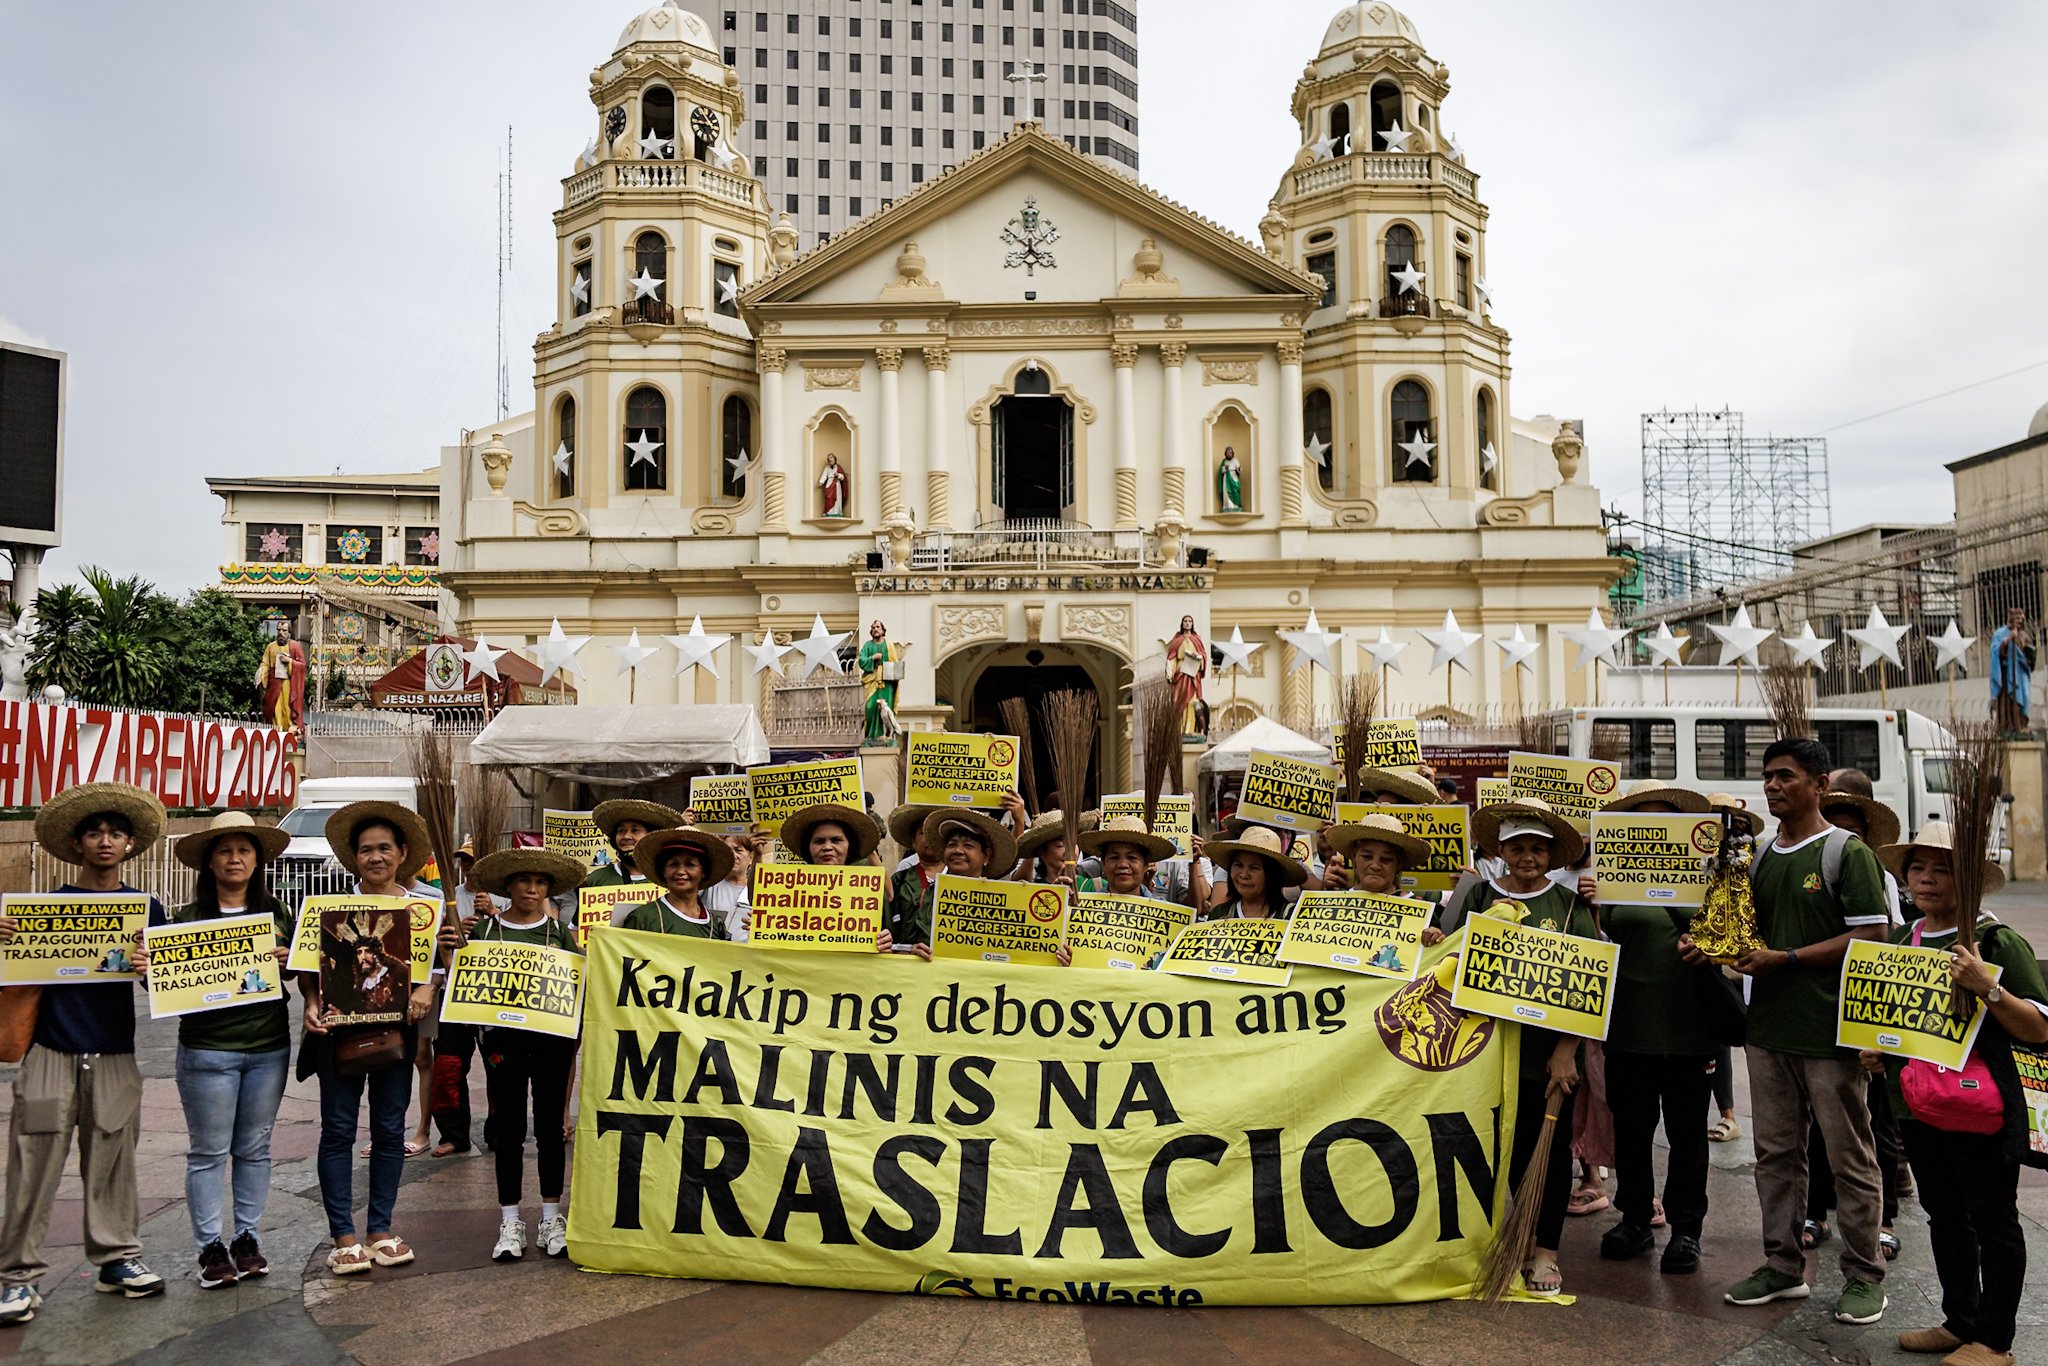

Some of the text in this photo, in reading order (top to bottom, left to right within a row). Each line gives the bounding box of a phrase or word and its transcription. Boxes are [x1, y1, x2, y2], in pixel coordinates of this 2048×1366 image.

[383, 693, 498, 704] JESUS NAZAREO
[1395, 730, 1415, 739] ANG
[914, 744, 969, 754] ANG HINDI
[1397, 741, 1417, 753] NA
[228, 726, 297, 808] 2026
[913, 755, 984, 767] PAGKAKALAT
[1273, 760, 1320, 776] KALAKIP NG
[753, 766, 856, 783] IWASAN AT BAWASAN
[930, 768, 997, 780] PAGRESPETO
[1000, 772, 1012, 780] SA
[1251, 763, 1335, 789] DEBOSYON ANG
[1512, 766, 1567, 779] ANG HINDI
[693, 788, 746, 798] DEBOSYON
[756, 780, 840, 798] ANG BASURA
[912, 780, 1012, 792] POONG NAZARENO
[1249, 777, 1332, 806] MALINIS NA
[1512, 777, 1582, 793] PAGKAKALAT
[694, 800, 747, 812] MALINIS
[757, 792, 857, 809] SA PAGGUNITA NG
[1104, 803, 1138, 811] IWASAN
[1511, 790, 1595, 807] AY PAGRESPETO
[1417, 813, 1434, 821] NG
[545, 827, 603, 837] ANG BASURA
[1175, 825, 1188, 833] NG
[1428, 823, 1462, 834] ANG
[1597, 829, 1666, 839] ANG HINDI
[554, 839, 600, 847] PAGGUNITA
[1432, 839, 1460, 855] NA
[1597, 843, 1688, 855] PAGKAKALAT
[1596, 858, 1614, 868] AY
[758, 868, 881, 892] Ipagbunyi ang
[1597, 872, 1713, 884] POONG NAZAREN
[582, 887, 659, 907] Ipagbunyi
[756, 890, 879, 910] malinis na
[941, 890, 1006, 906] ANG HINDI
[8, 904, 144, 915] IWASAN AT BAWASAN
[940, 904, 1025, 922] PAGKAKALAT
[1118, 903, 1189, 924] AT BAWASAN
[1303, 898, 1425, 917] IWASAN AT BAWASAN
[52, 918, 120, 931] BASURA
[753, 910, 877, 932] Traslacion.
[1072, 911, 1167, 934] ANG BASURA
[1299, 908, 1399, 927] ANG BASURA
[150, 925, 270, 948] IWASAN AT BAWASAN
[938, 918, 1059, 939] AY PAGRESPETO SA
[1068, 925, 1162, 947] SA PAGGUNITA
[1184, 929, 1260, 938] DEBOSYON
[1294, 921, 1417, 943] SA PAGGUNITA NG
[4, 934, 116, 946] SA PAGGUNITA
[413, 938, 430, 948] SA
[754, 932, 873, 944] EcoWaste Coalition
[938, 932, 1058, 954] POONG NAZARENO
[1067, 937, 1146, 955] TRASLACION
[1178, 938, 1257, 951] MALINIS
[1290, 932, 1373, 950] TRASLACION
[1502, 929, 1579, 953] KALAKIP NG
[4, 948, 98, 959] TRASLACION
[152, 940, 252, 964] ANG BASURA
[488, 948, 556, 963] KALAKIP NG
[1471, 932, 1609, 972] DEBOSYON ANG
[153, 953, 272, 978] SA PAGGUNITA NG
[459, 956, 579, 980] DEBOSYON ANG
[1878, 951, 1950, 971] KALAKIP NG
[1469, 951, 1602, 995] MALINIS NA
[1848, 960, 1931, 983] DEBOSYON
[153, 971, 236, 992] TRASLACION
[457, 971, 574, 1000] MALINIS NA
[1846, 979, 1925, 1008] MALINIS
[616, 956, 1346, 1050] Kalakip ng debosyon ang
[605, 1029, 1185, 1130] MALINIS NA
[596, 1104, 1502, 1260] TRASLACION
[993, 1278, 1204, 1306] EcoWaste
